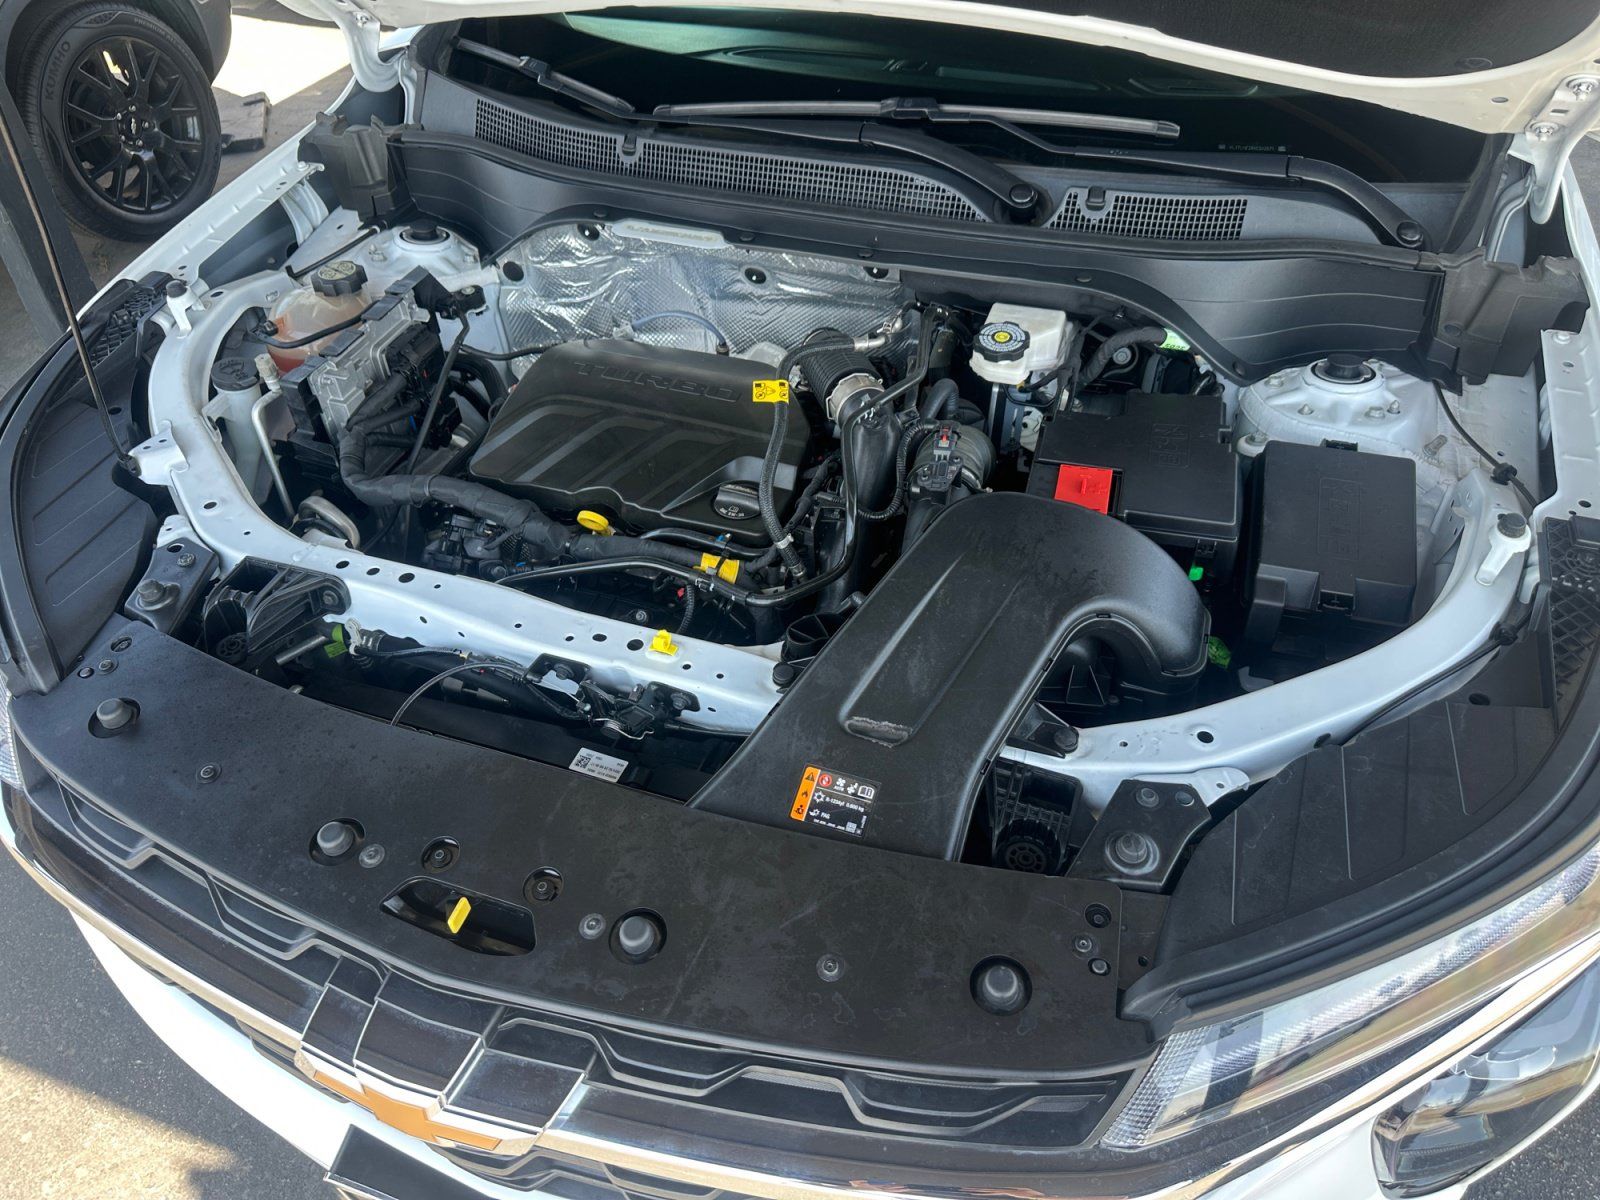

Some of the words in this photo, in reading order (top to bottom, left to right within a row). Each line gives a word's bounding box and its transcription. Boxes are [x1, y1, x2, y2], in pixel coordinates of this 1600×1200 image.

[44, 41, 71, 97] KUMHO
[573, 361, 743, 403] TURBO
[820, 811, 831, 819] PAG
[858, 805, 865, 813] kg
